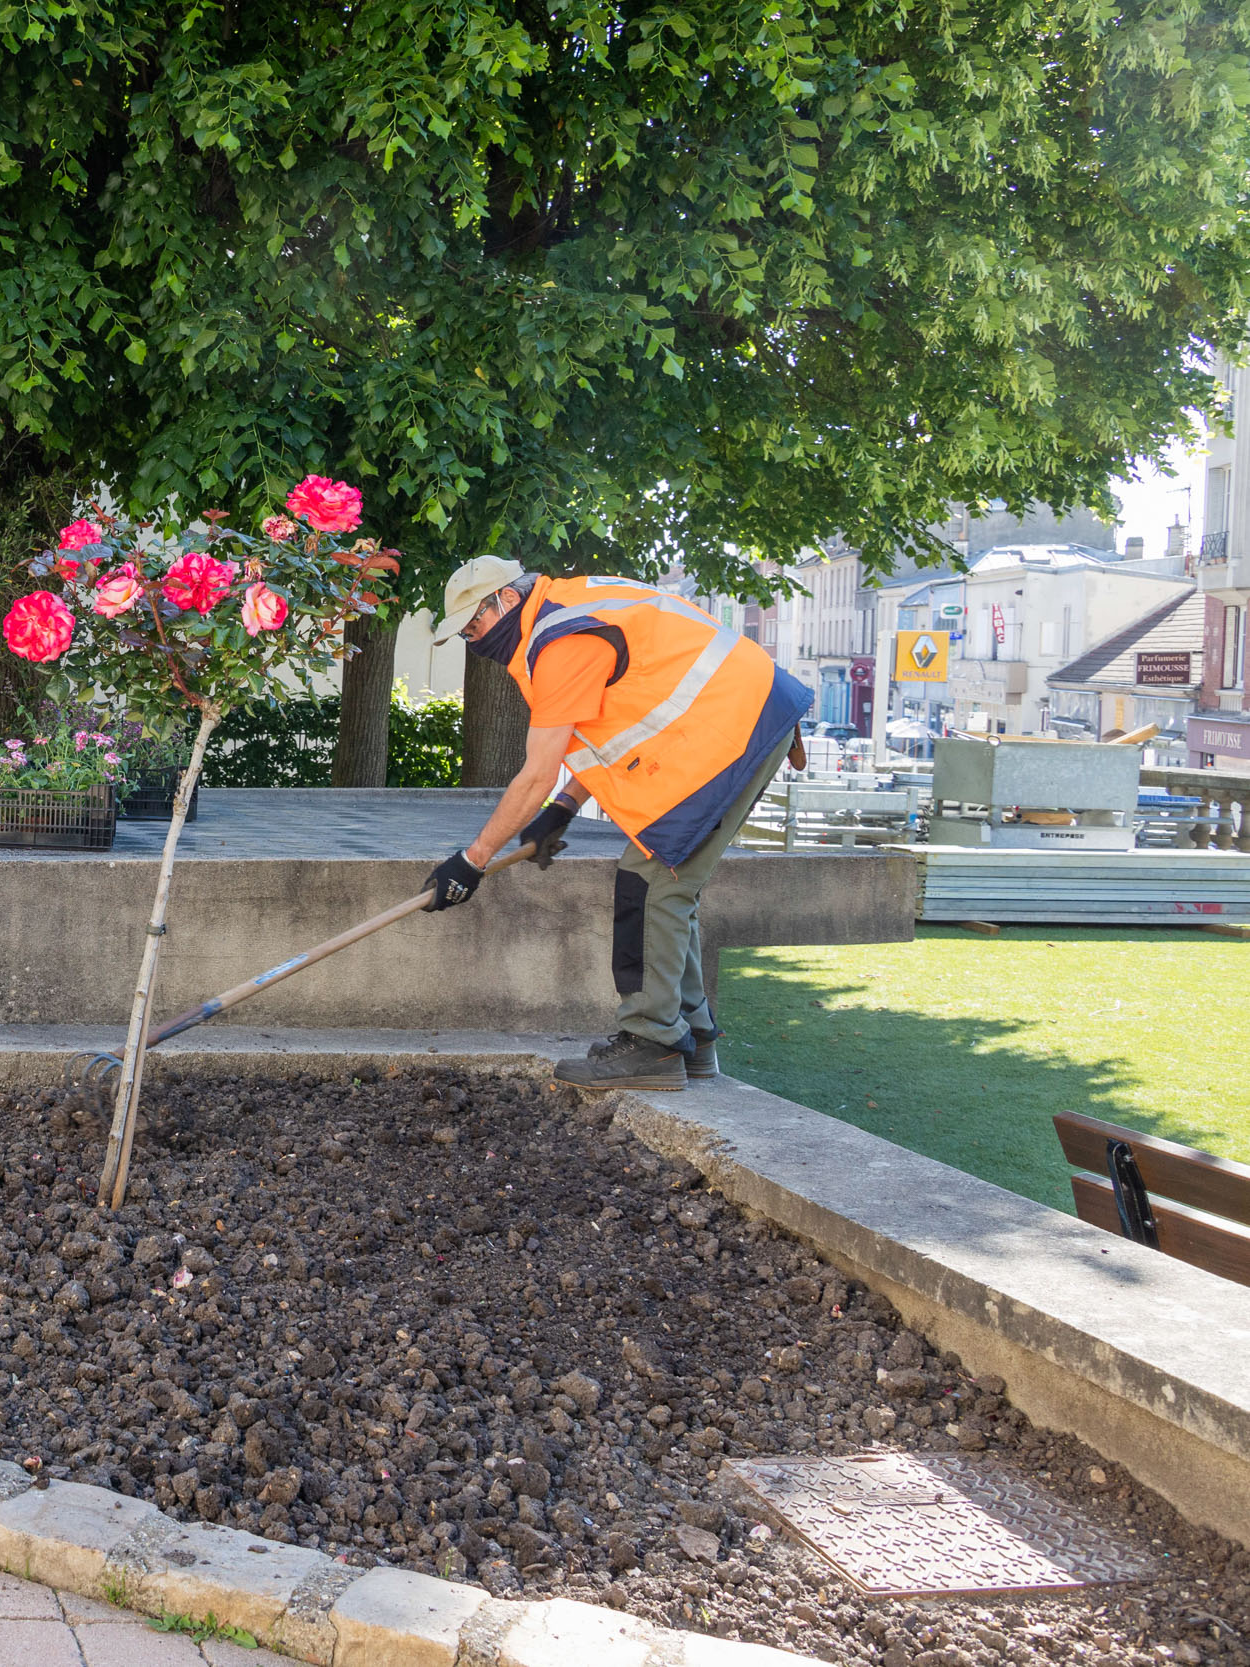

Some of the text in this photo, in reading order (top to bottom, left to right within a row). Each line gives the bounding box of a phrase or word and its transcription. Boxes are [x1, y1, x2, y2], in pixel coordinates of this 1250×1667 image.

[993, 601, 1005, 642] TABAC
[1141, 653, 1186, 662] Parfumerie
[1138, 664, 1189, 672] FRIMOUSSE
[902, 671, 942, 679] RENAULT
[1203, 730, 1242, 748] FRIMOUSSE
